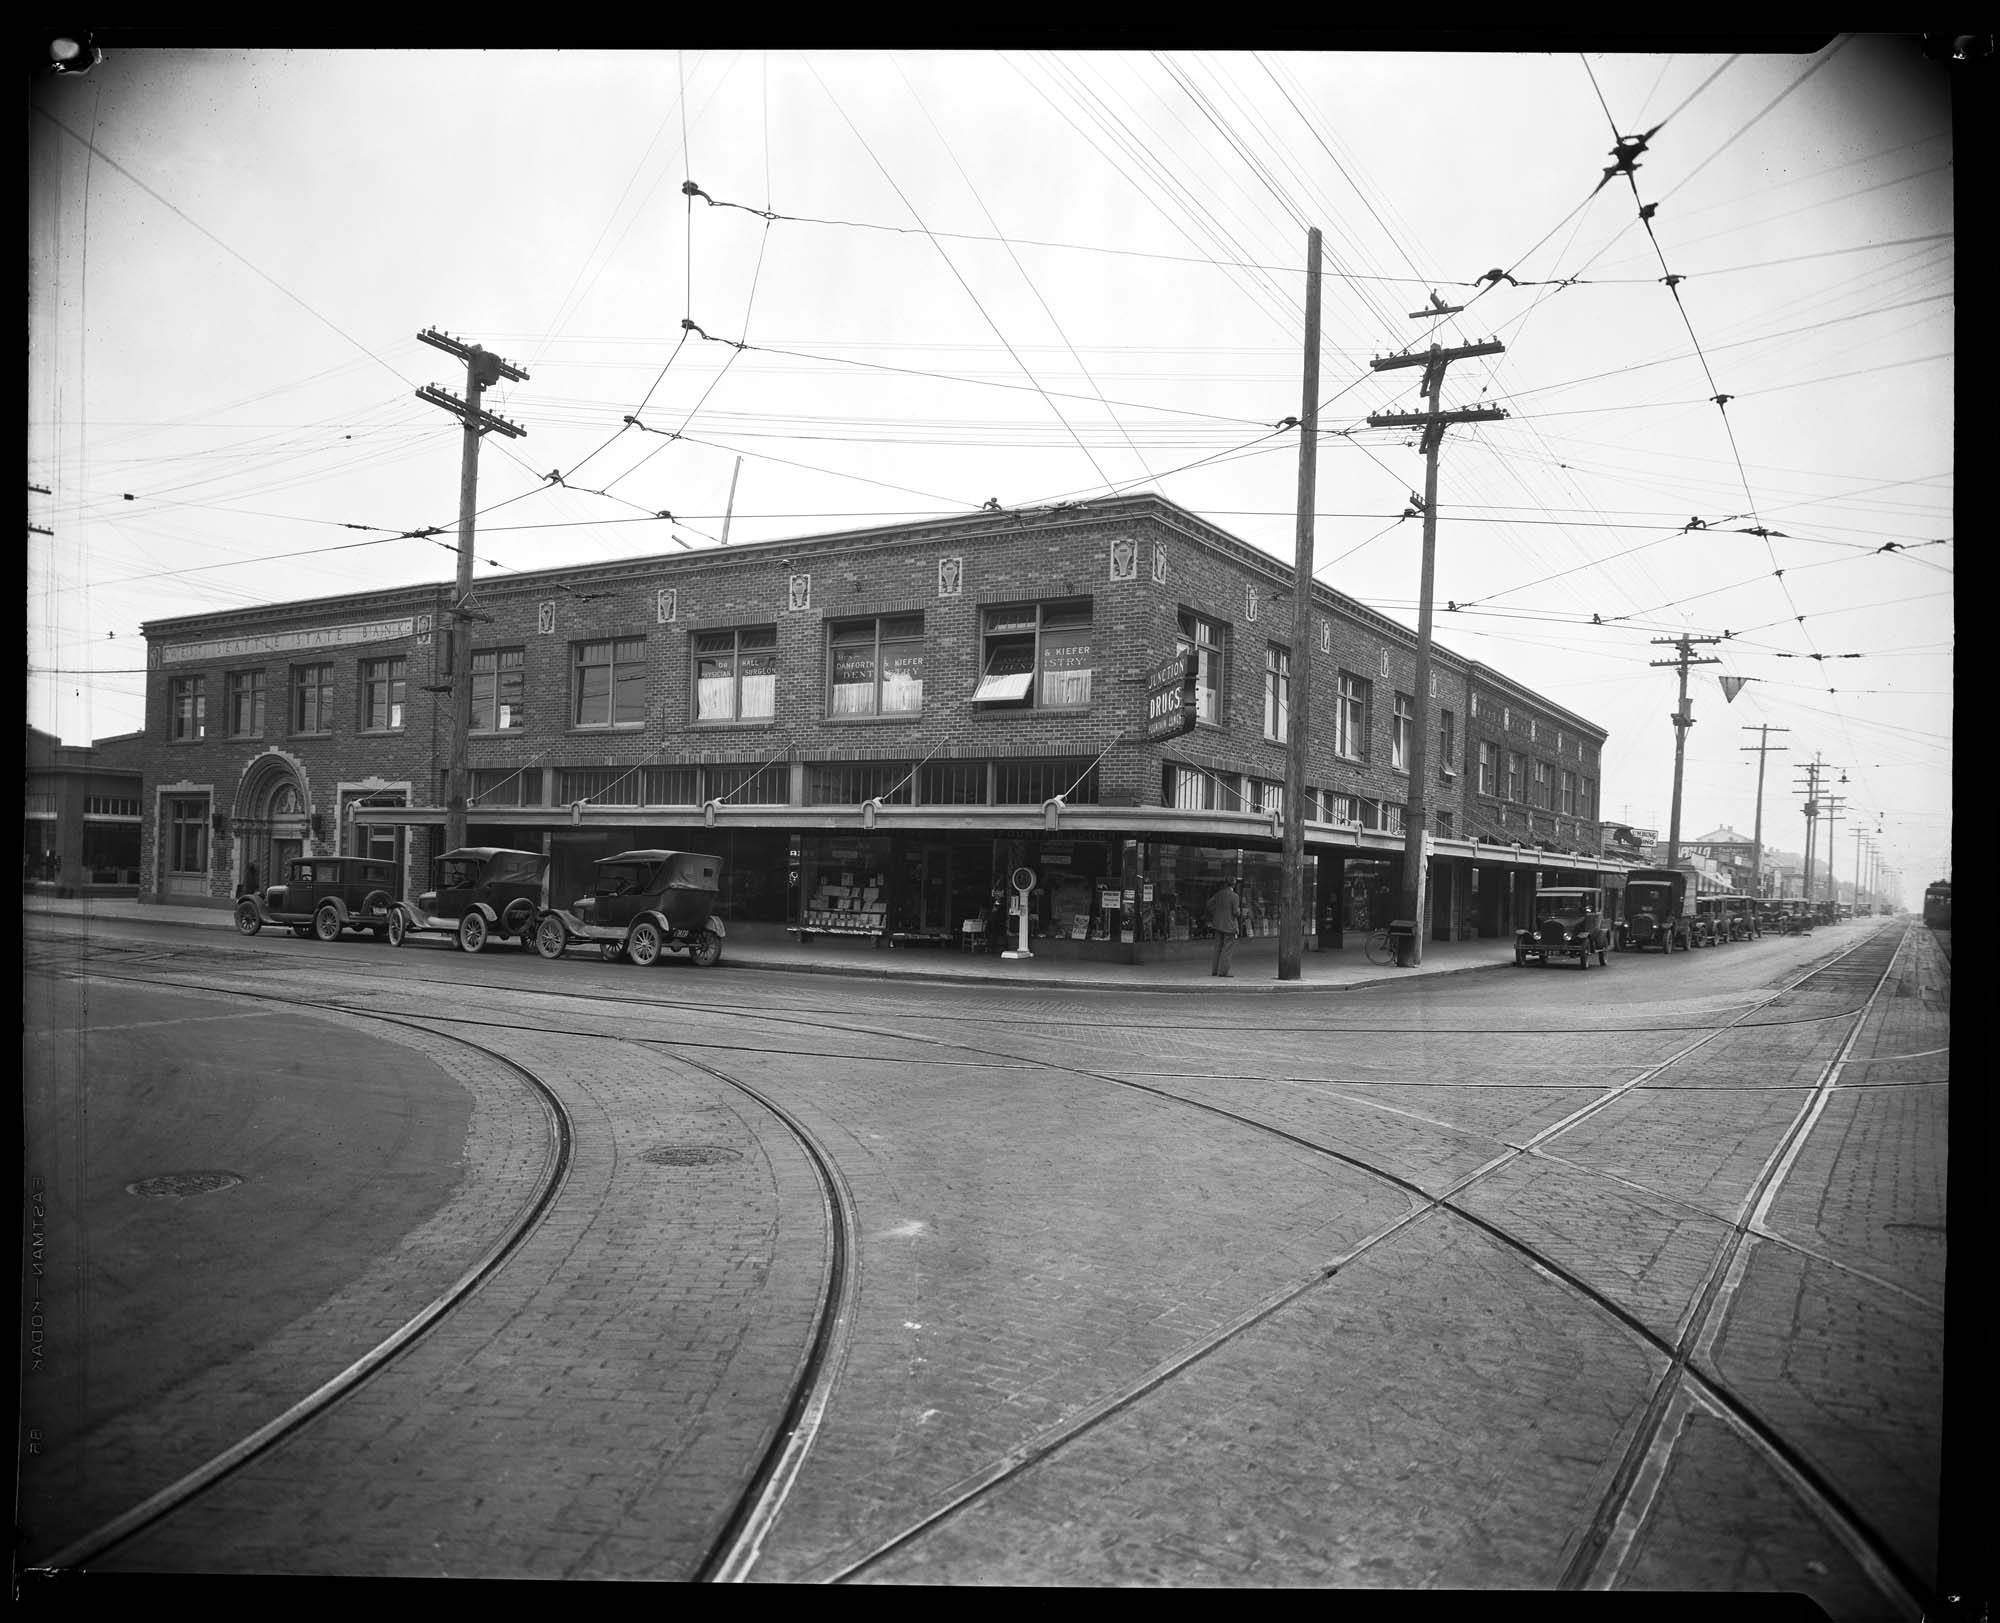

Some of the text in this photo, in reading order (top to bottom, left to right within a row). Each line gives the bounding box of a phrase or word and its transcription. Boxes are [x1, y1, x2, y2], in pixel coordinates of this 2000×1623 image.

[170, 622, 403, 658] WEST SEATTLE STATE BANK
[1044, 646, 1090, 657] & KIEFER
[895, 657, 923, 667] KIEFER
[1148, 659, 1185, 690] JUNCTION
[1150, 686, 1182, 719] DRUGS
